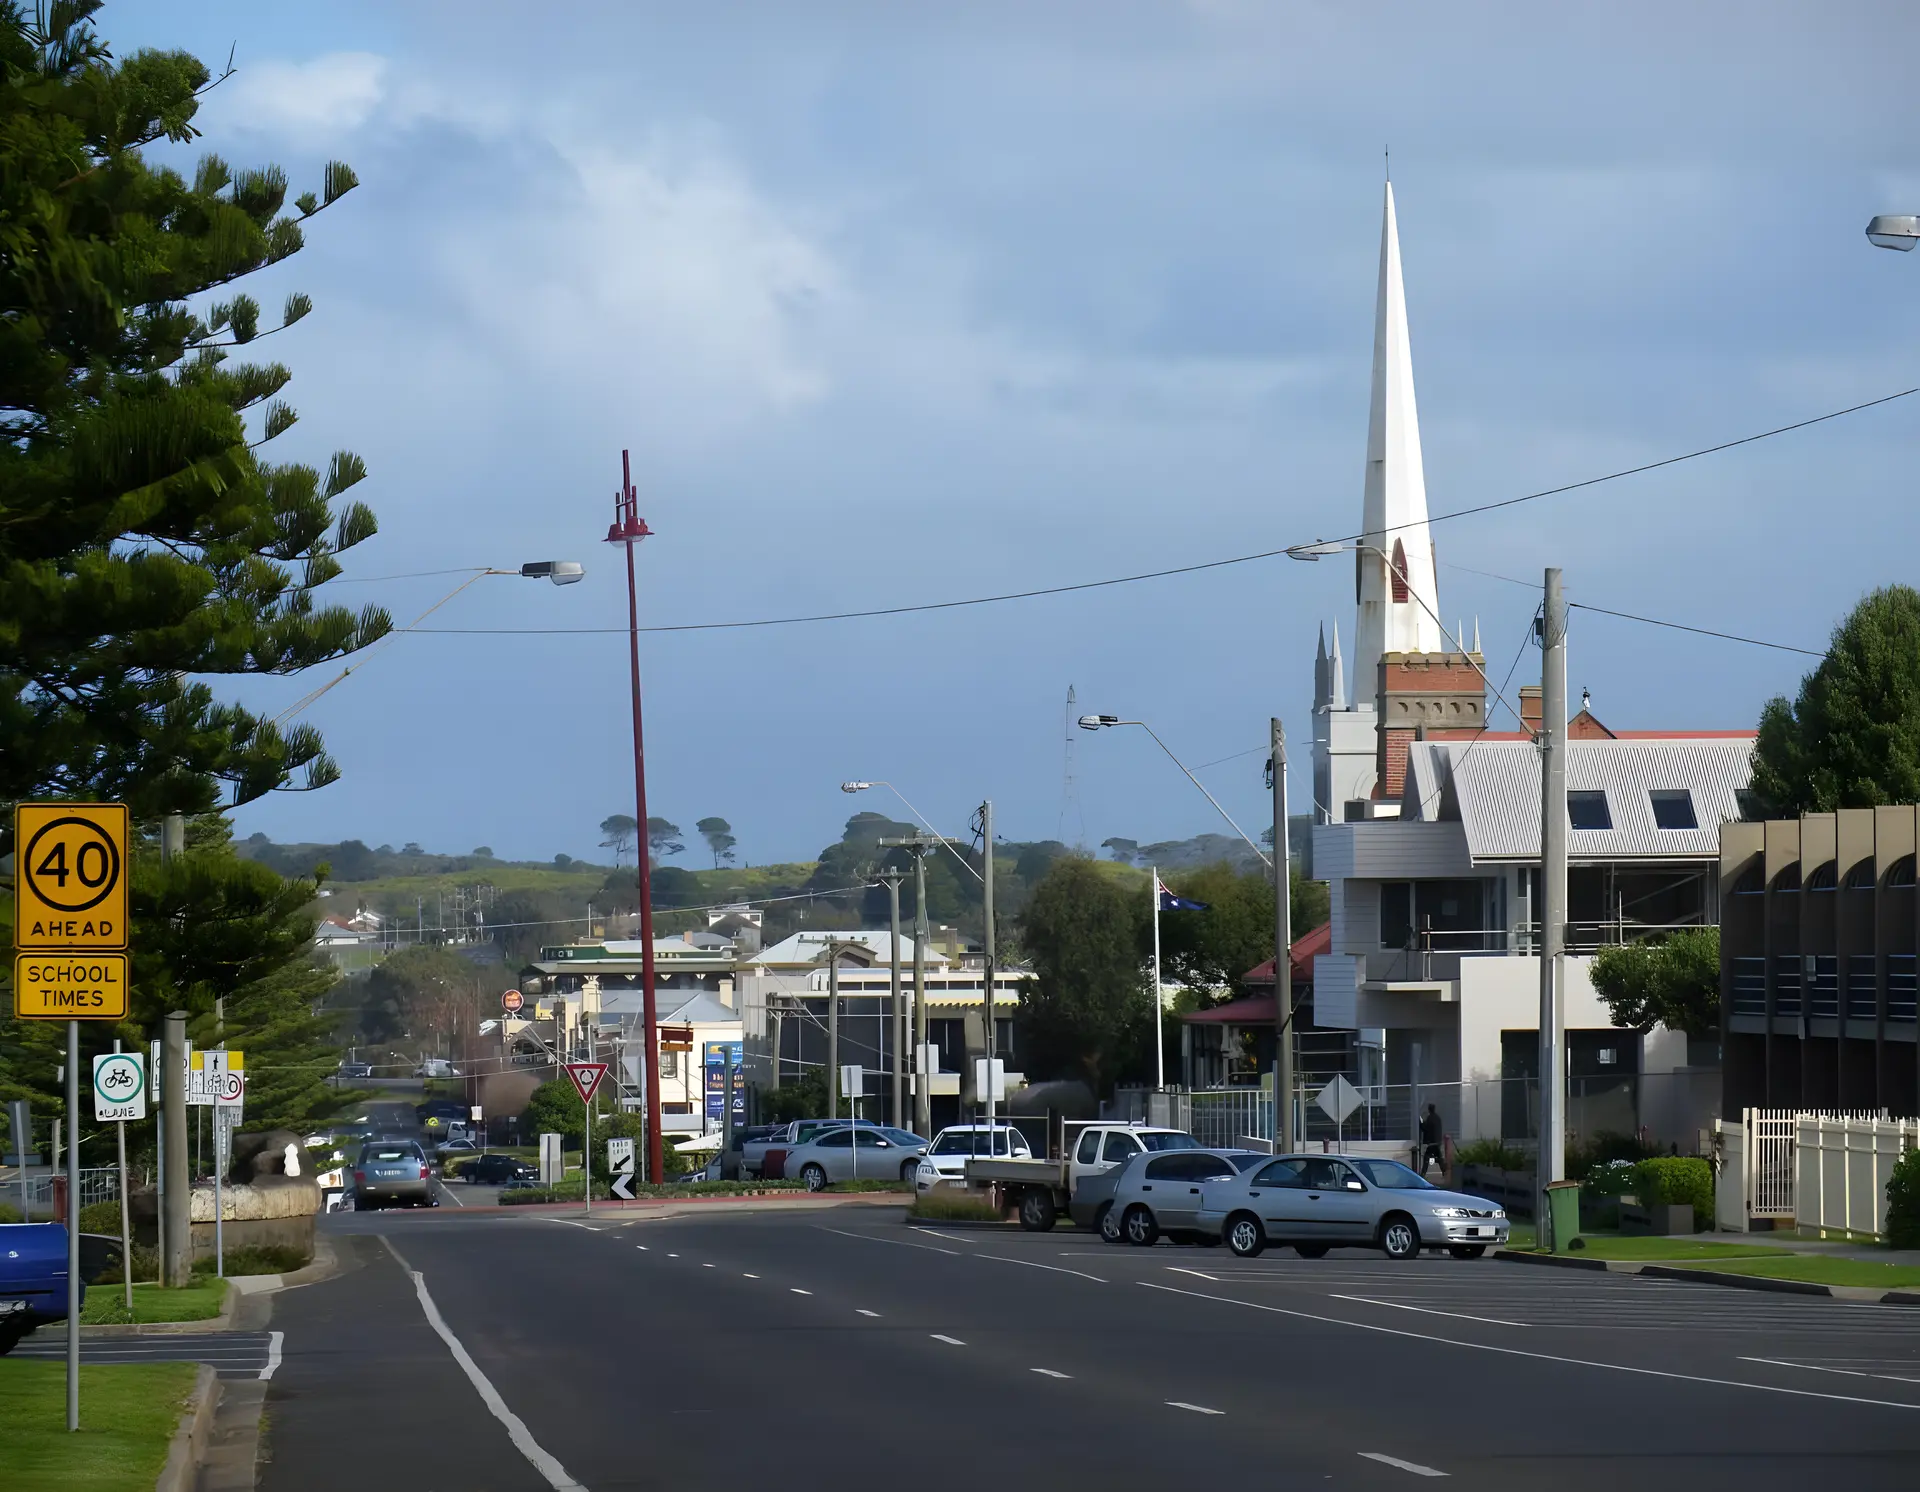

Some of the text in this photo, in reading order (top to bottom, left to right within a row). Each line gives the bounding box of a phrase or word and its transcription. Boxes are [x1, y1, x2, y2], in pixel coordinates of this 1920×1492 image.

[35, 841, 109, 888] 40
[30, 921, 113, 937] AHEAD
[27, 965, 118, 983] SCHOOL
[39, 989, 104, 1007] TIMES
